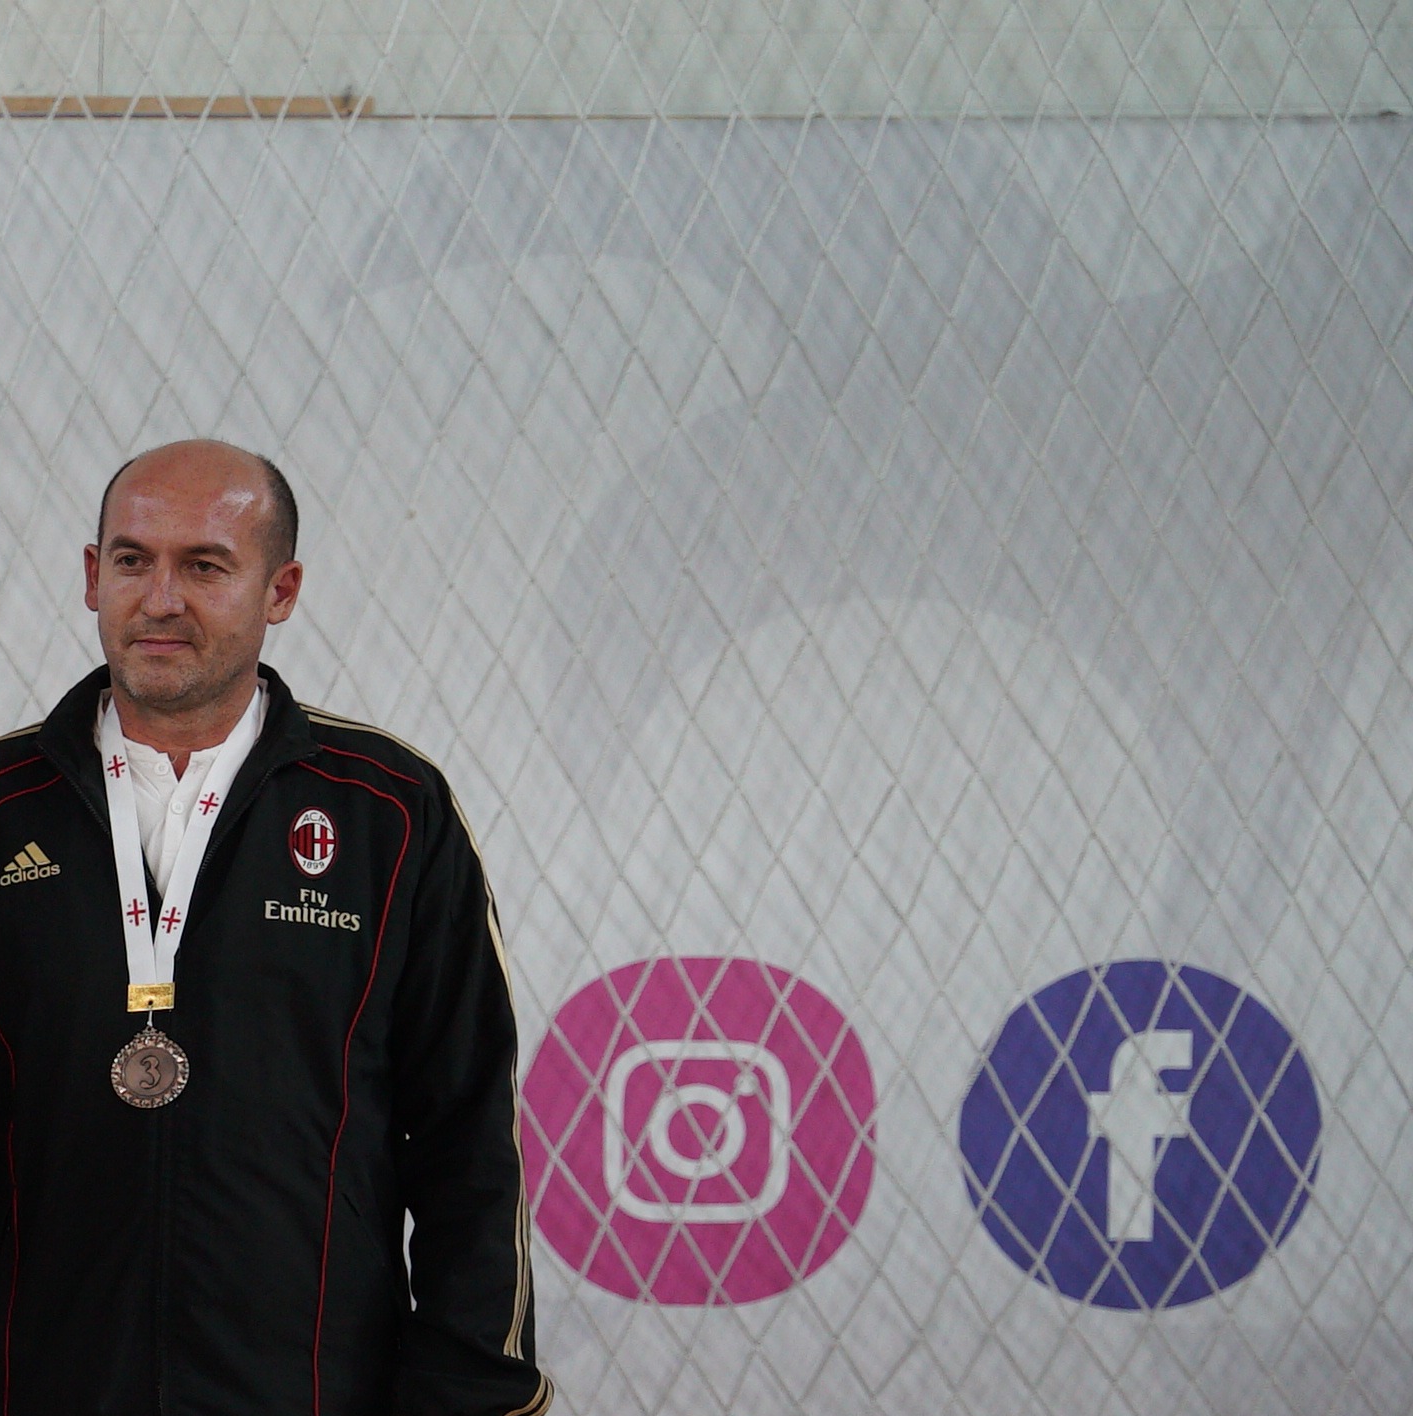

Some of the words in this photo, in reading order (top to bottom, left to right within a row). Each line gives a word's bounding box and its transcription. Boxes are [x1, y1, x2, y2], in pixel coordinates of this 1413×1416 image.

[301, 812, 328, 825] ACM
[302, 860, 325, 869] 1899
[0, 864, 61, 886] adidas
[300, 888, 328, 907] Fly
[264, 901, 361, 931] Emirates
[139, 1055, 162, 1090] 3
